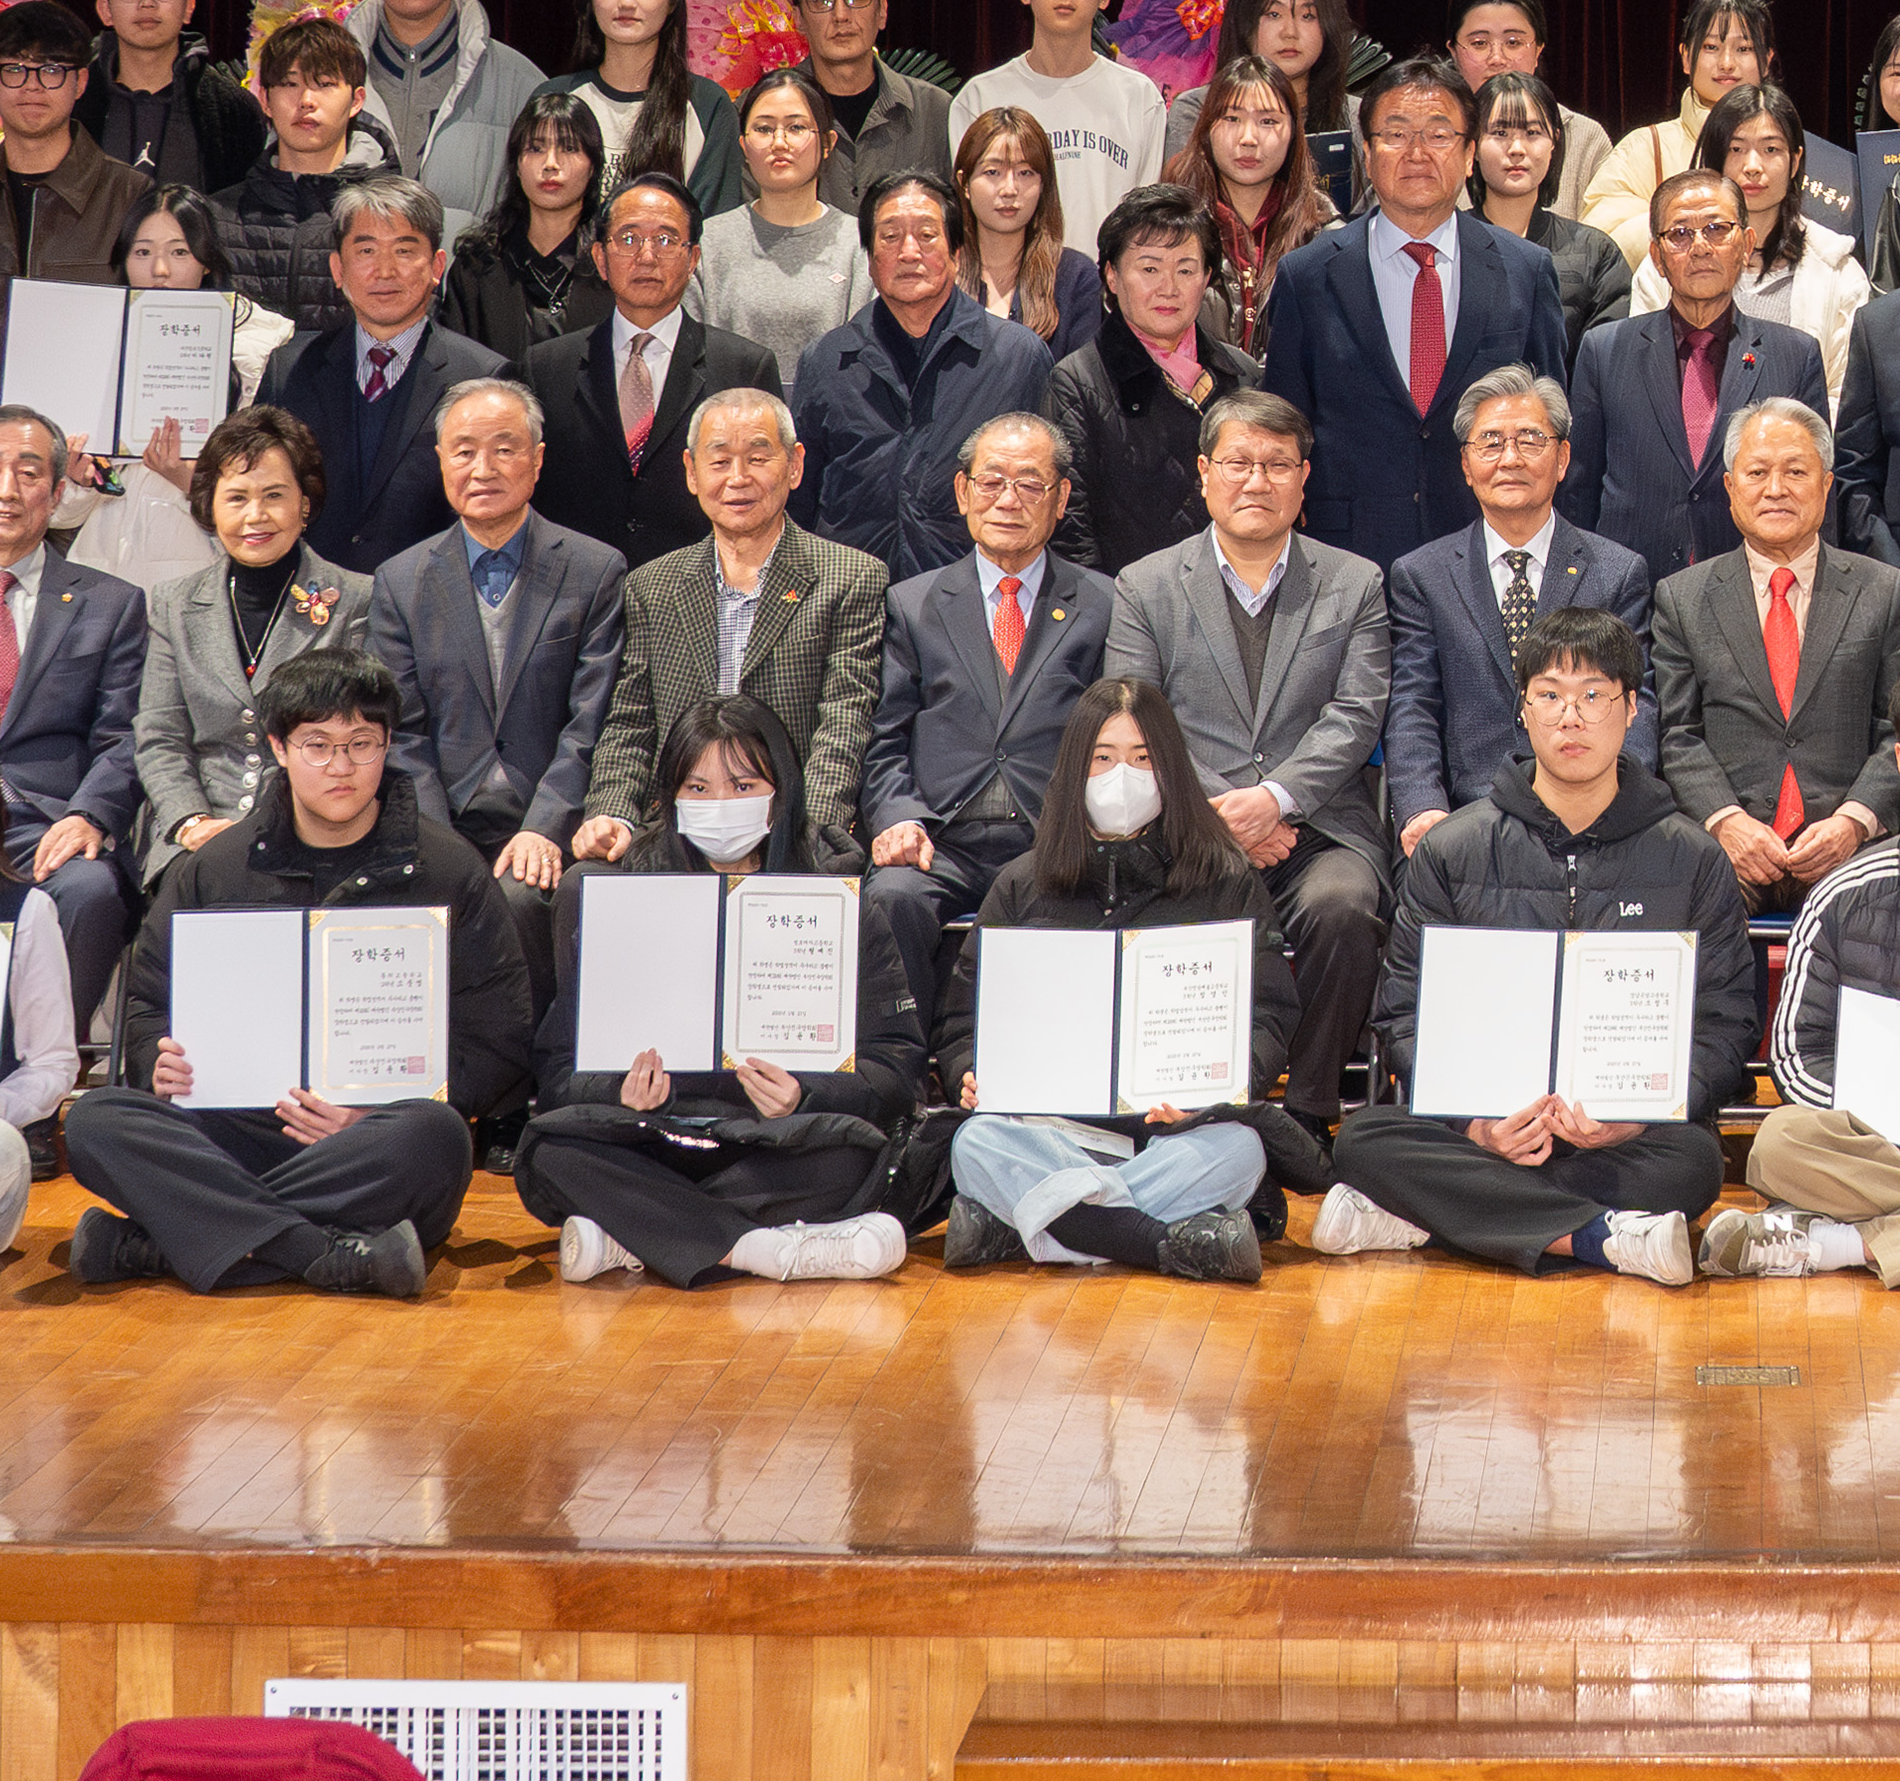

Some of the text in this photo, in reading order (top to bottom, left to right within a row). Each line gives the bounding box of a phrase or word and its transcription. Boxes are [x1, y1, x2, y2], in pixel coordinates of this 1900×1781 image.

[1083, 130, 1096, 150] IS
[1099, 135, 1129, 170] OVER
[1619, 901, 1644, 917] Lee
[765, 914, 818, 930] 장학증서
[351, 946, 406, 964] 장학증서
[1162, 961, 1213, 978] 장학증서
[1603, 968, 1655, 983] 장학증서
